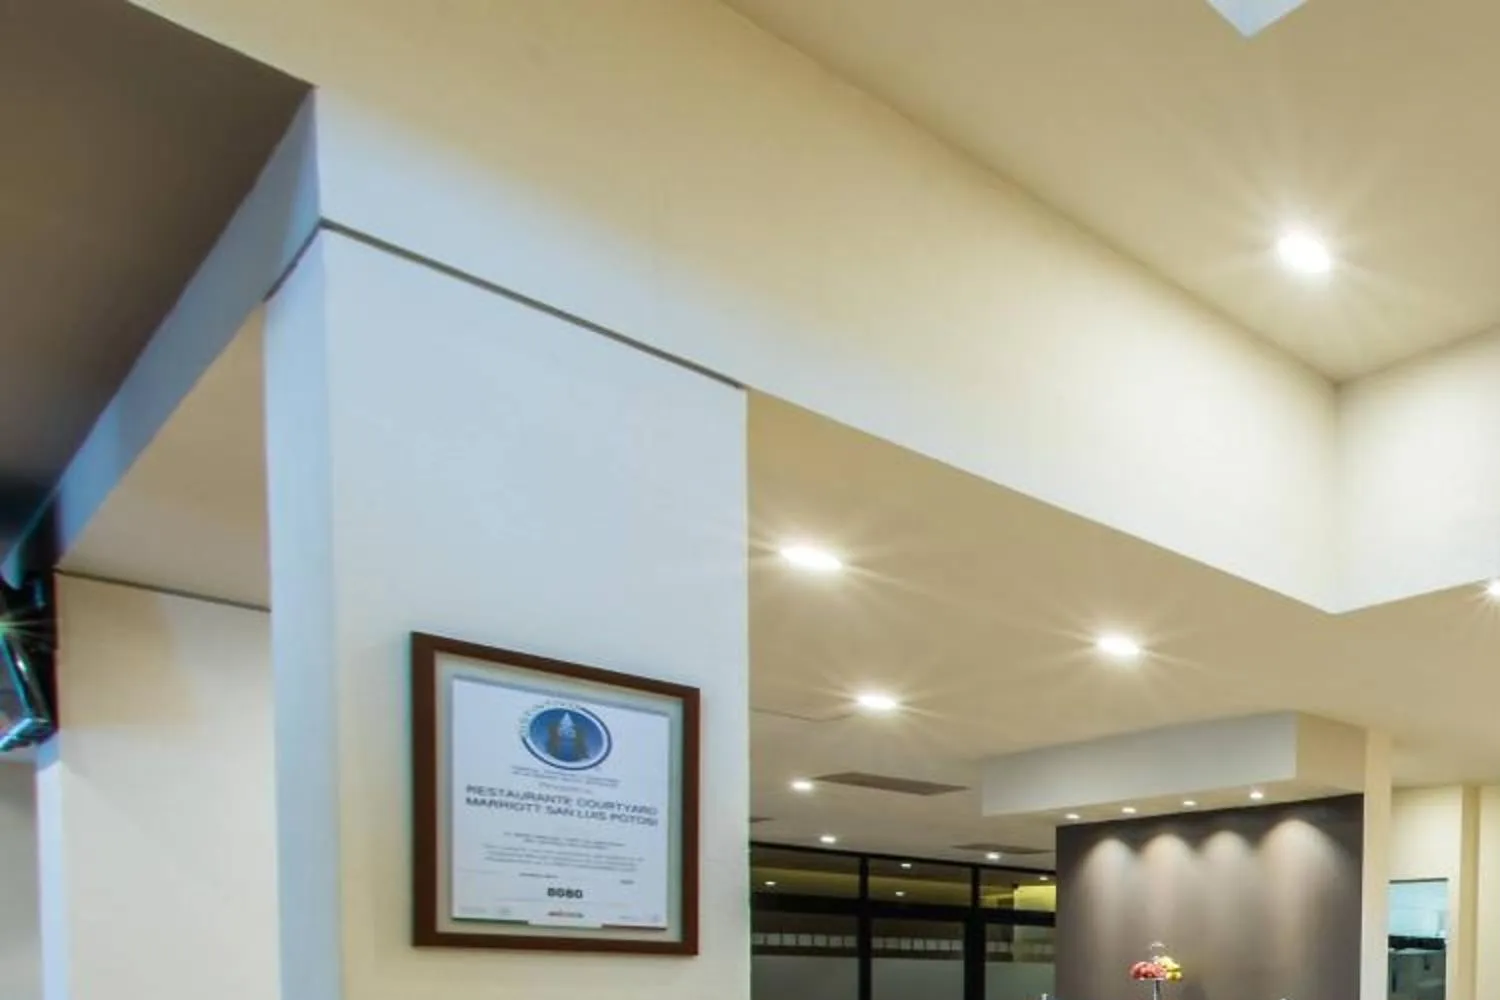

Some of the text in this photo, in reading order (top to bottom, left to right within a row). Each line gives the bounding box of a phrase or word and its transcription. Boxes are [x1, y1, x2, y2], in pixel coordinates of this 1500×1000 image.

[465, 784, 573, 804] RESTAURANTE
[577, 798, 659, 815] COURTYARD
[465, 797, 541, 813] MARRIOTT
[545, 804, 574, 817] SAN
[576, 808, 607, 821] LUIS
